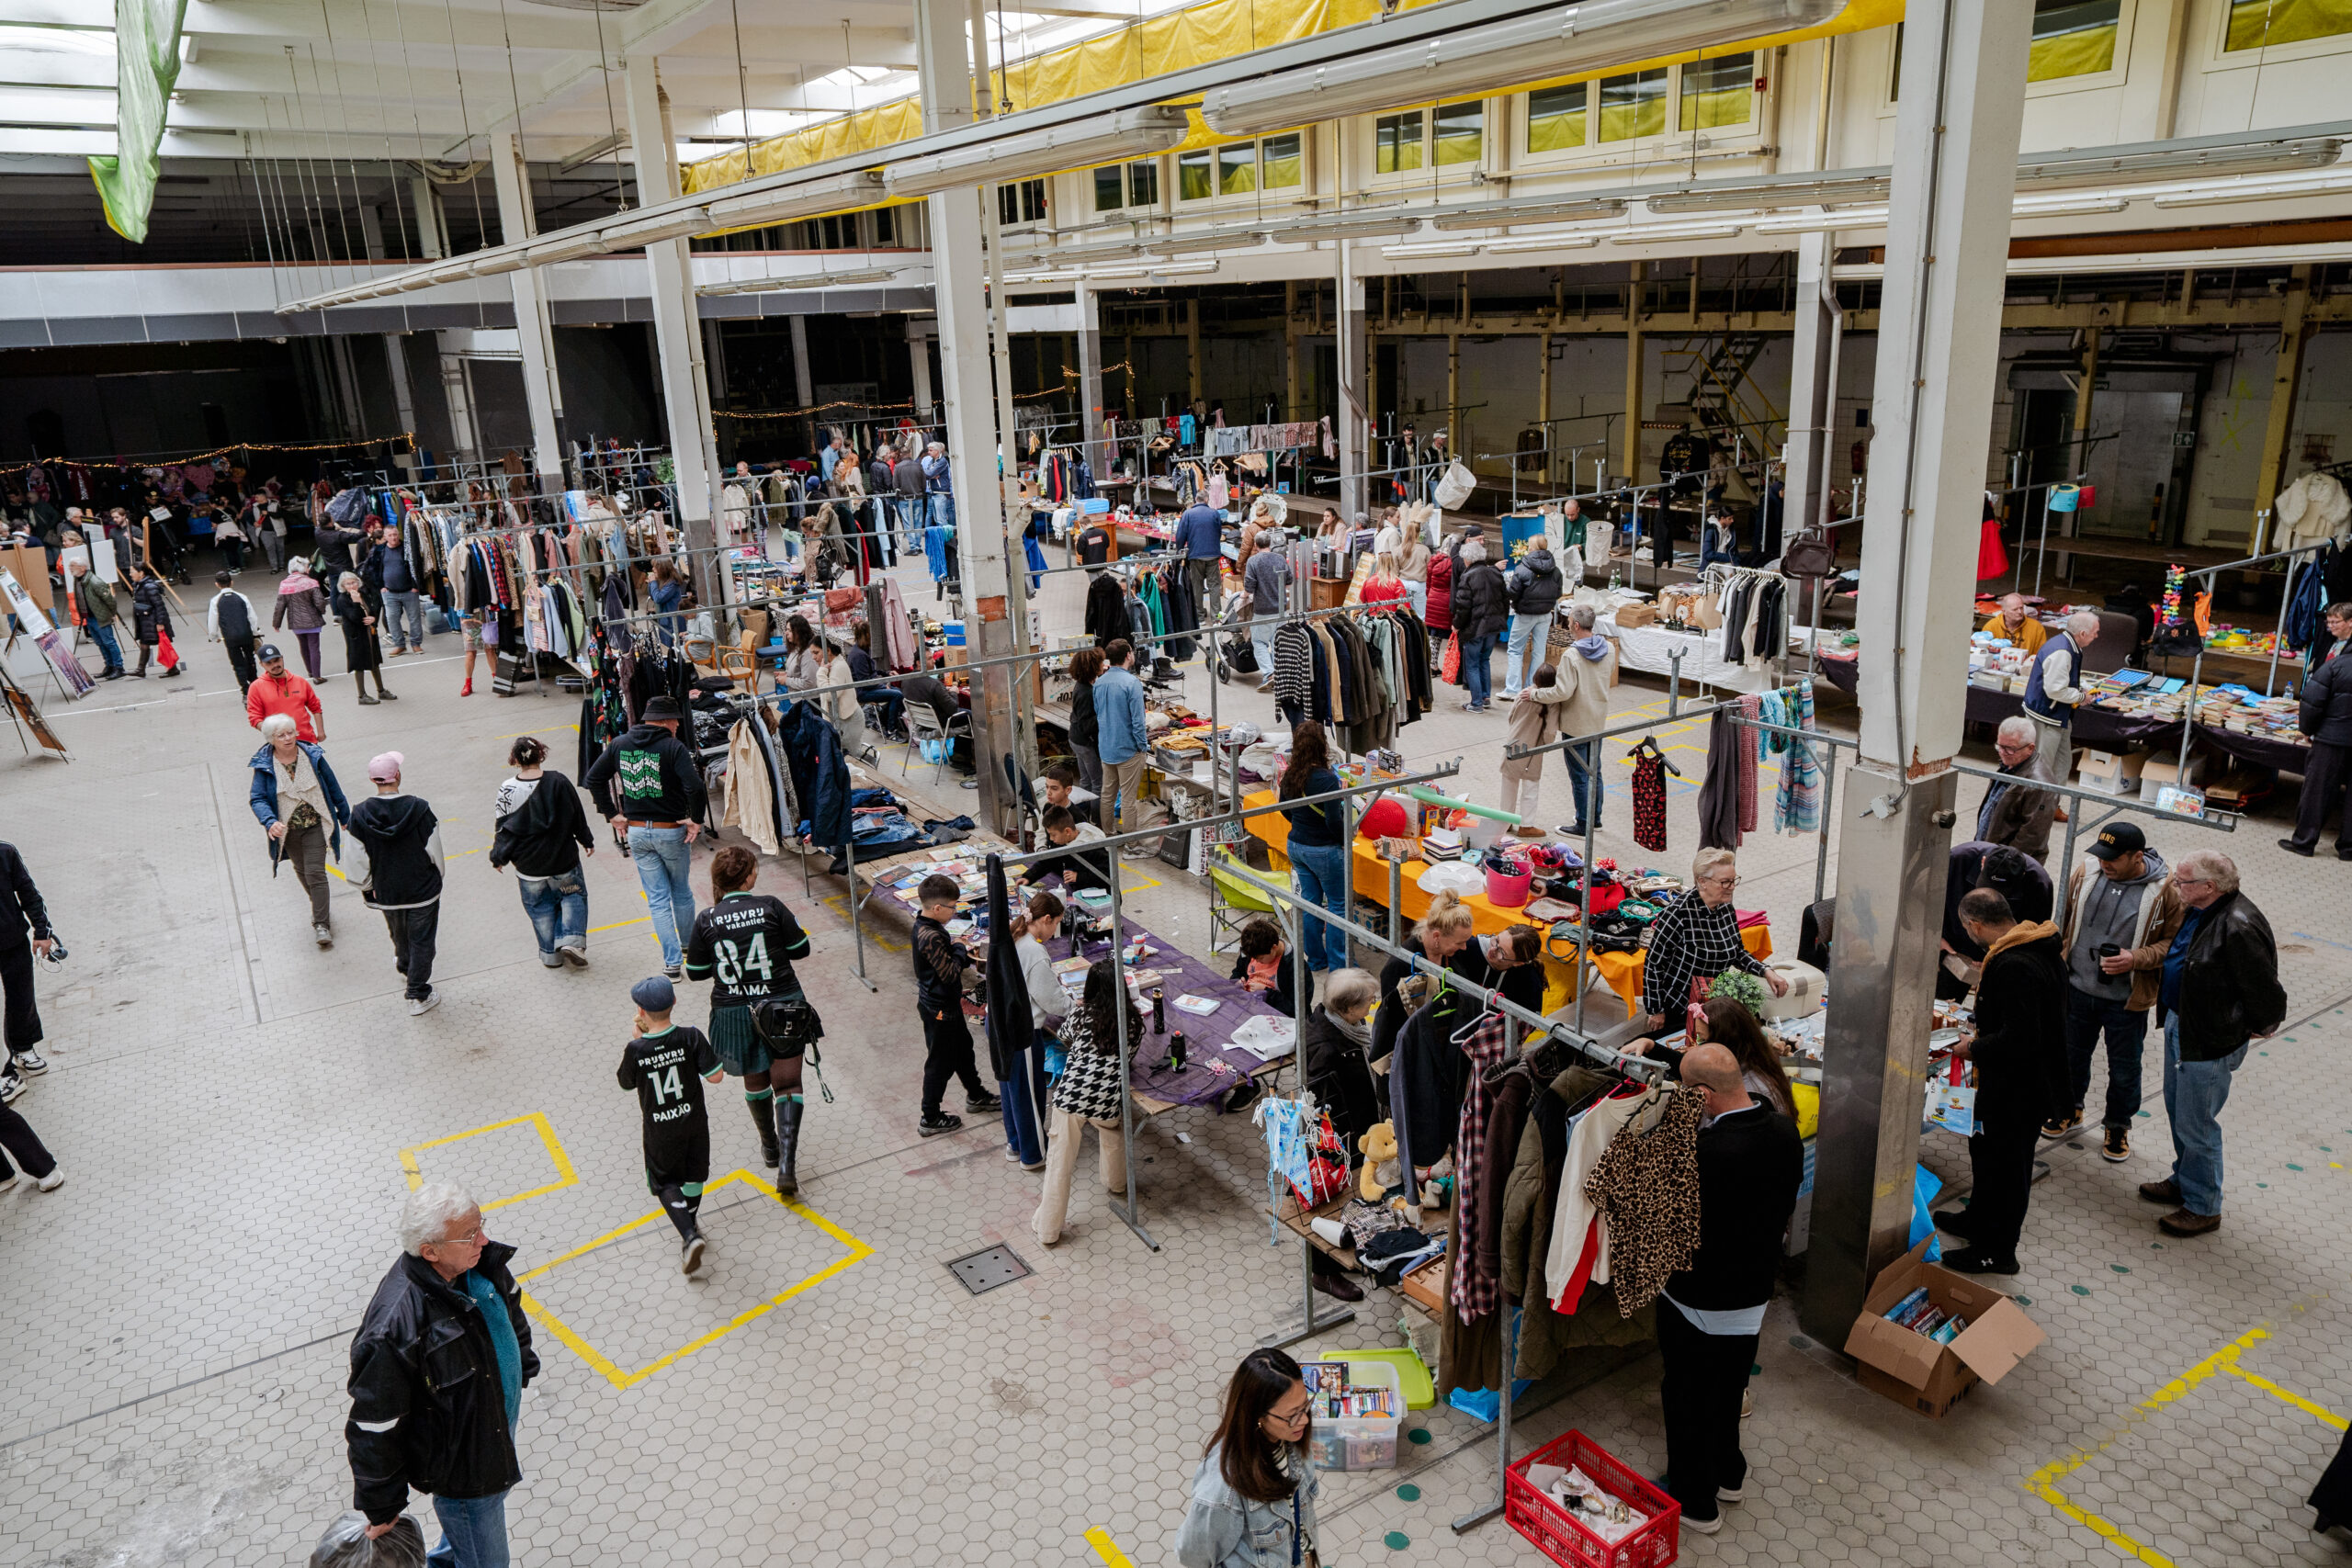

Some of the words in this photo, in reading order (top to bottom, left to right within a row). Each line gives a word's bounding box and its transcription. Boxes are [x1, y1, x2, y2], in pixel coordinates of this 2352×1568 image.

[726, 917, 765, 931] vakanties
[714, 931, 773, 985] 84
[653, 1055, 685, 1069] vakanties
[647, 1065, 684, 1105] 14
